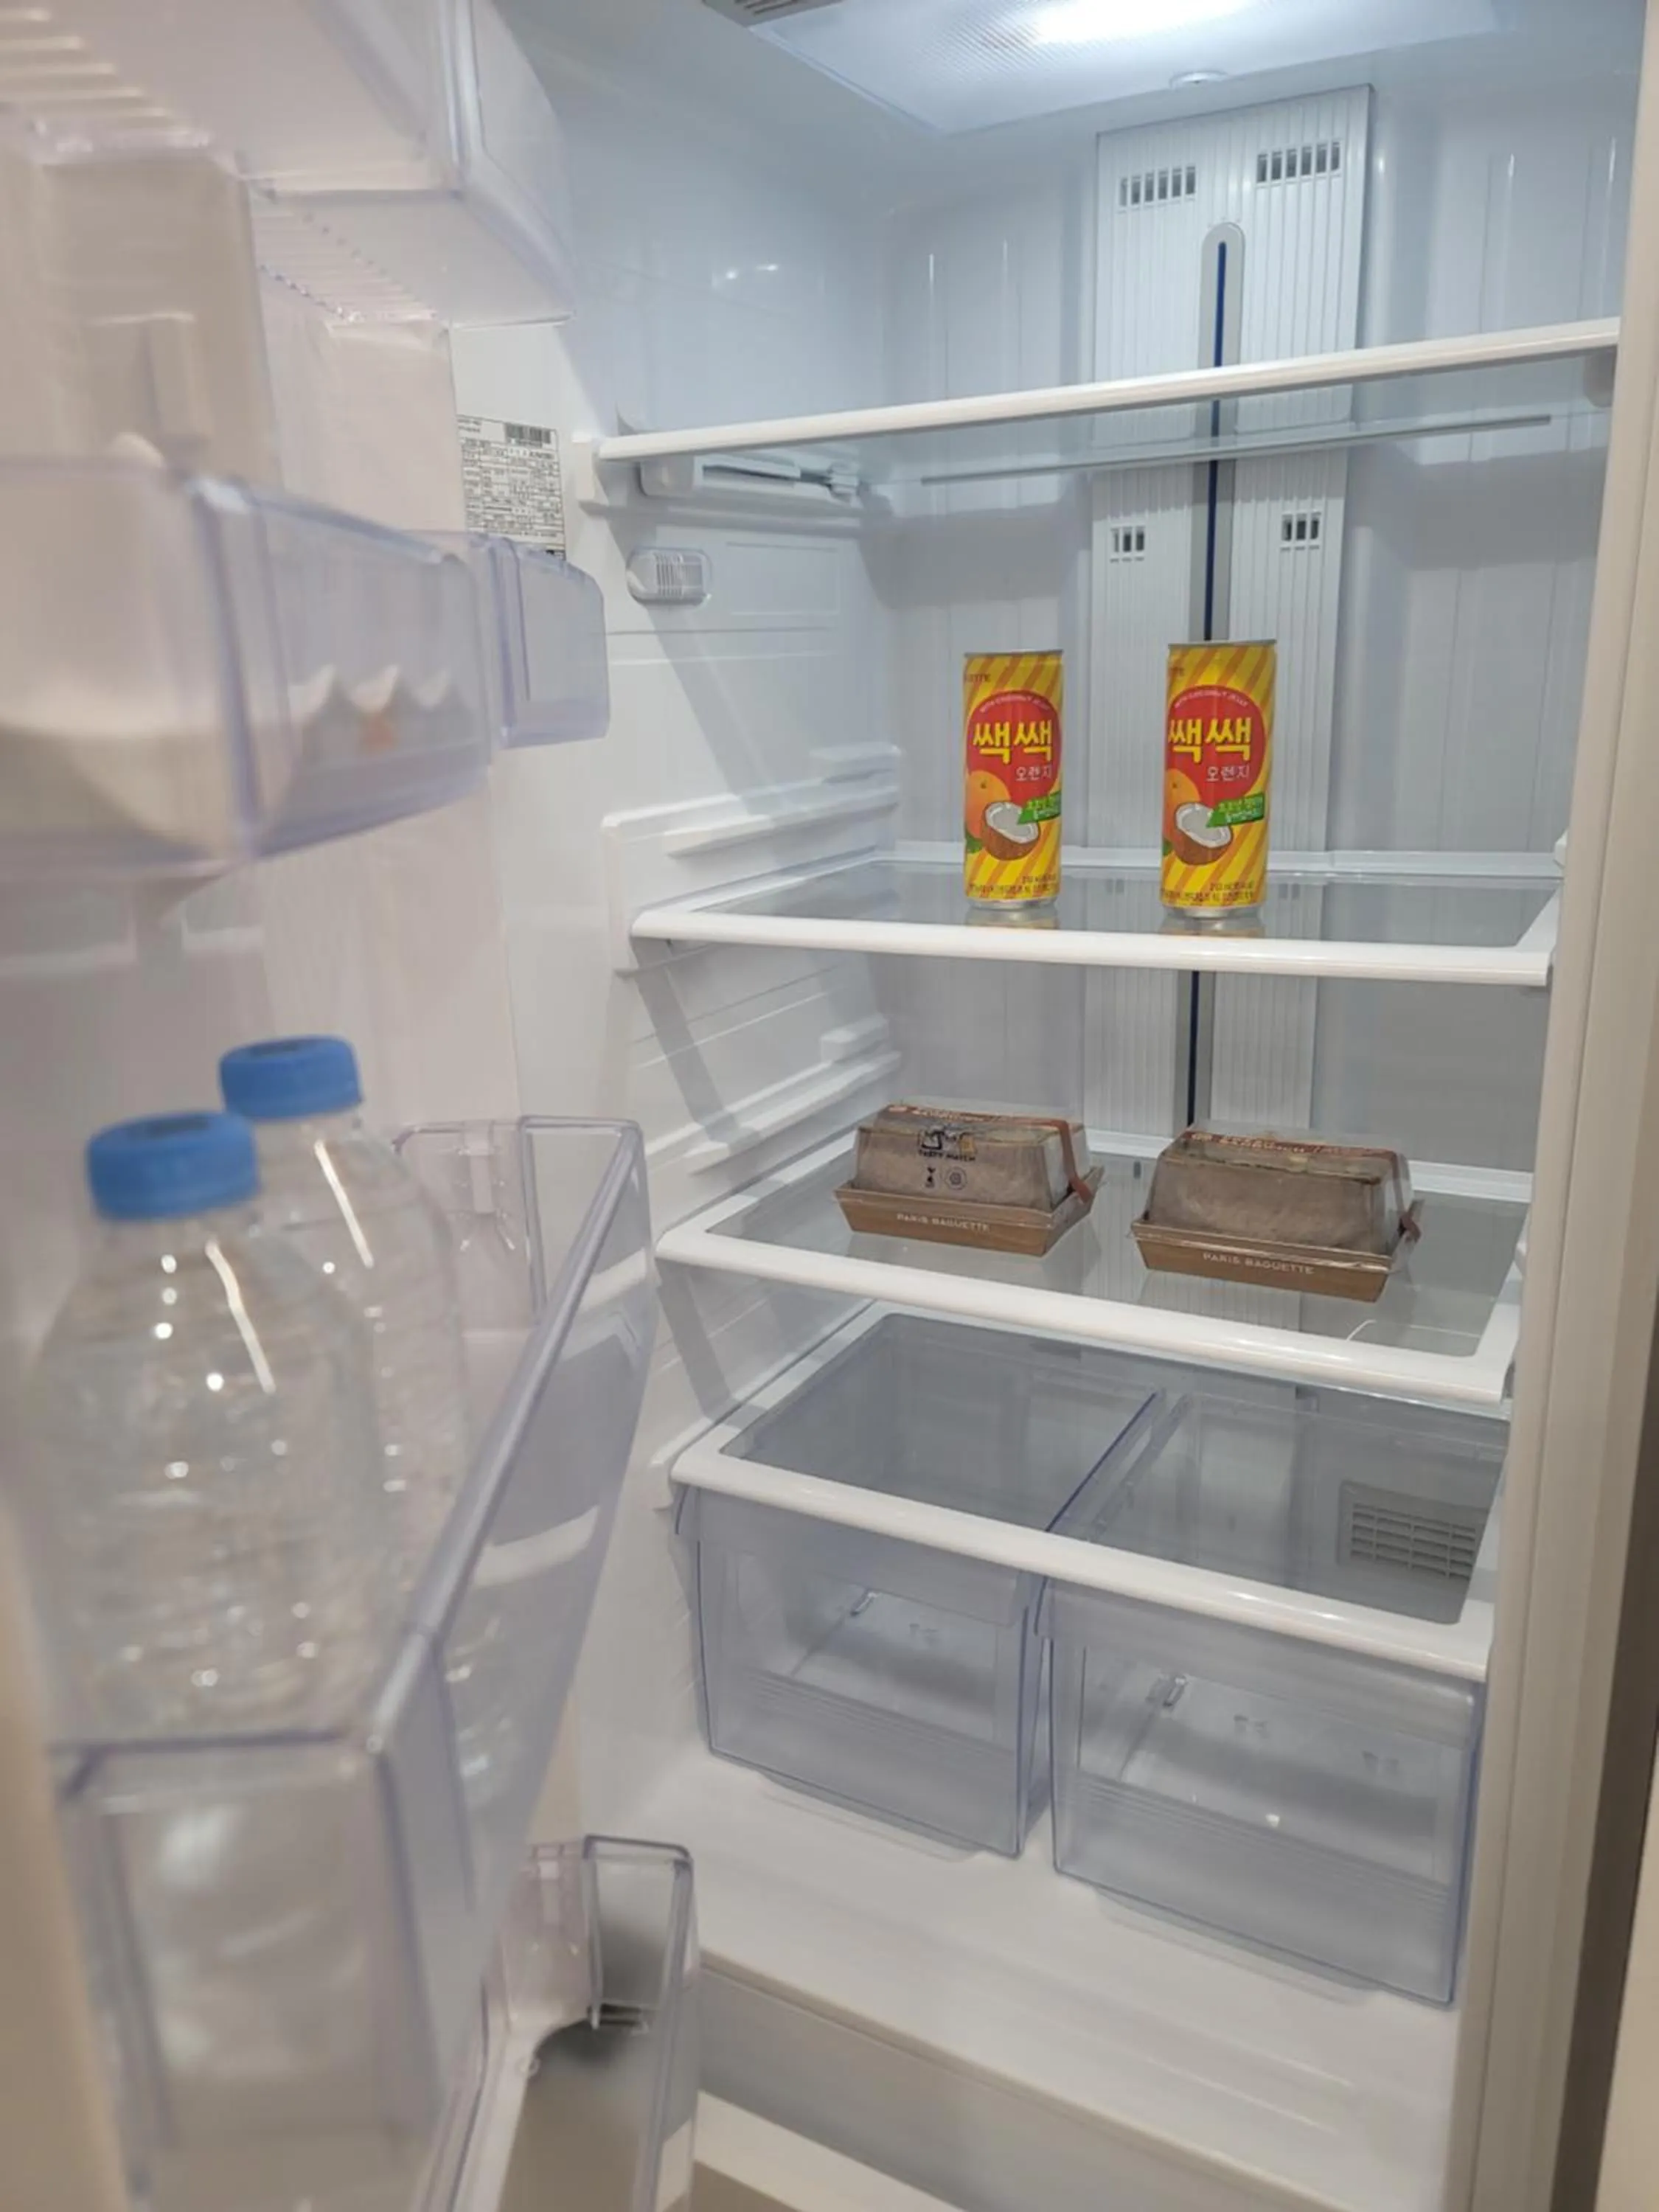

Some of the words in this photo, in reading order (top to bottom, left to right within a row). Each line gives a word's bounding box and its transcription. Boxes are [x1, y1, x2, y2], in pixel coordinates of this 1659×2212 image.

[972, 719, 1054, 765] 쌕쌕
[1167, 716, 1253, 764] 쌕쌕
[1015, 765, 1052, 782] 오렌지
[1205, 764, 1251, 782] 오렌지
[897, 1213, 928, 1224] PARIS
[931, 1217, 990, 1232] BAGUETTE
[1203, 1252, 1241, 1265] PARIS
[1245, 1257, 1315, 1275] BAGUETTE
